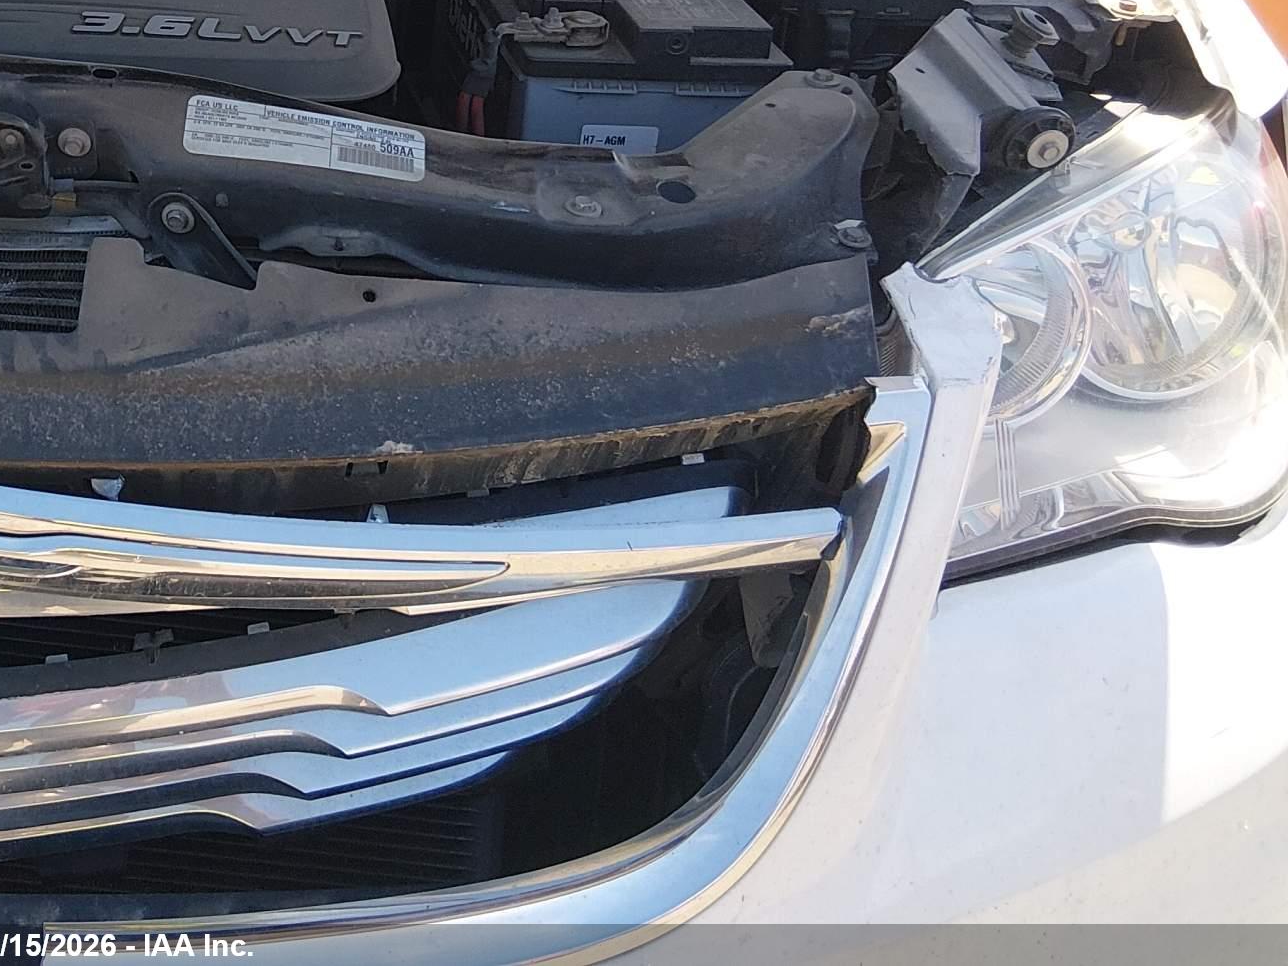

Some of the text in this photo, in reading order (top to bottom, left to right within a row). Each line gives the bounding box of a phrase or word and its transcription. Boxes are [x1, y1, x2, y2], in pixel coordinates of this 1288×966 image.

[196, 99, 210, 107] FCA
[267, 110, 294, 120] VEHICLE
[297, 114, 330, 126] EMISSION
[333, 120, 364, 132] CONTROL
[366, 127, 415, 140] INFORMATION
[380, 142, 415, 157] 509AA
